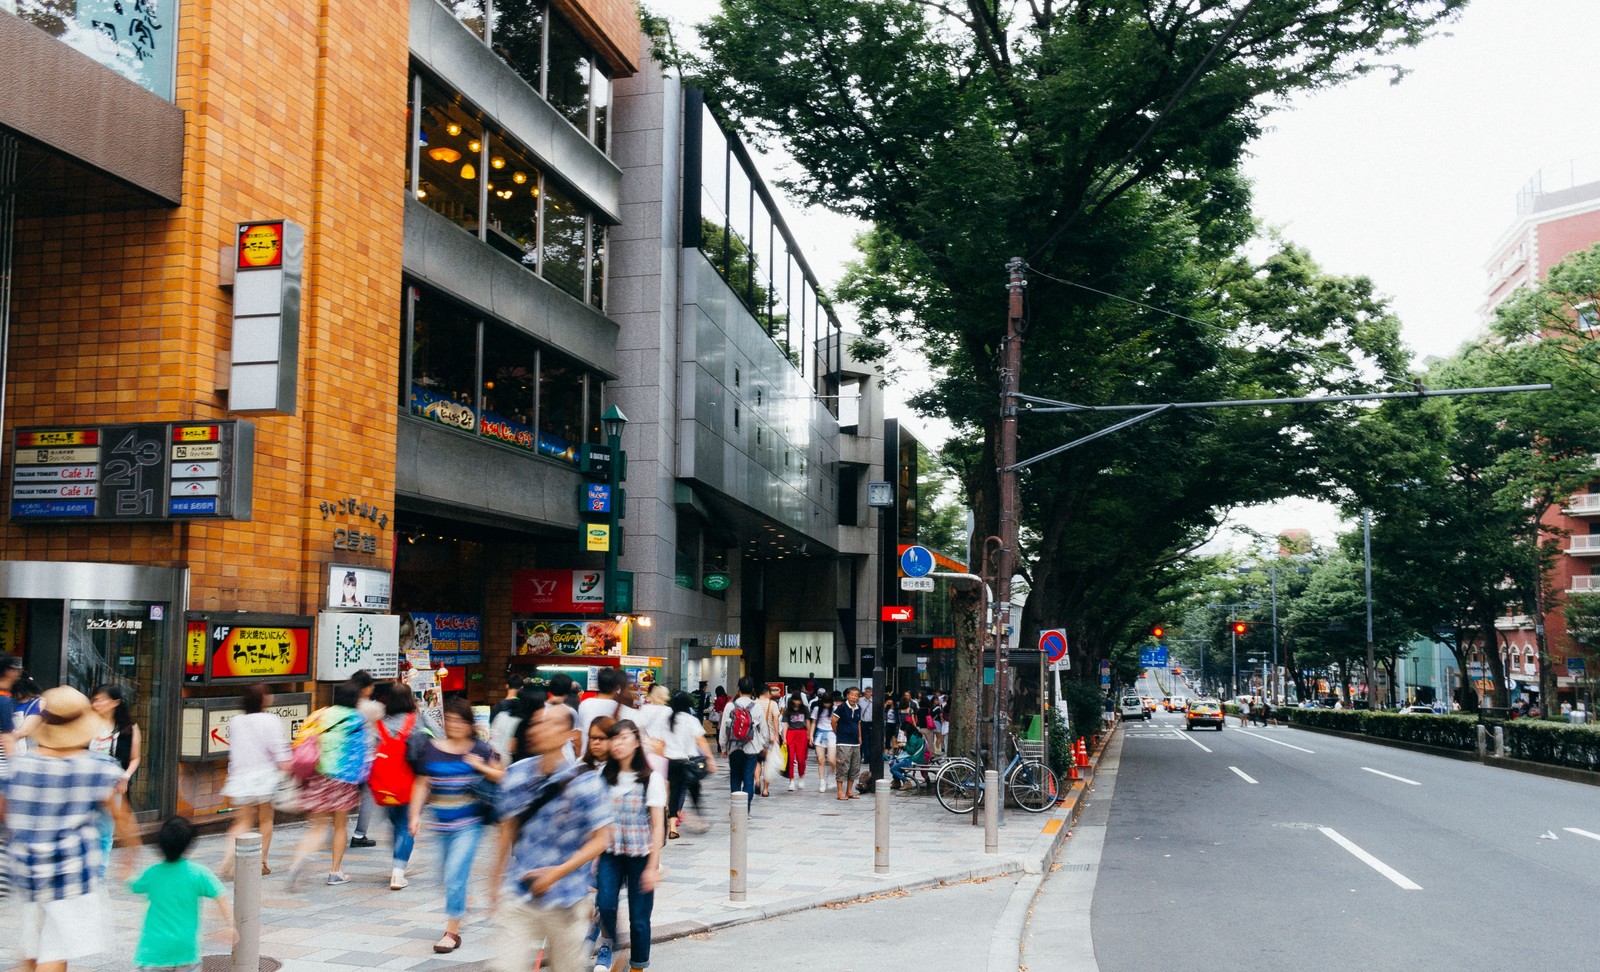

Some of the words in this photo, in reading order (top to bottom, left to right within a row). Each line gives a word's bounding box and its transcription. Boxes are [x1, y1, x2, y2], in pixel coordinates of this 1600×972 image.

[111, 429, 139, 455] 4
[135, 439, 162, 467] 3
[61, 467, 82, 479] Café
[85, 468, 95, 478] Jr.
[103, 459, 132, 485] 2
[60, 484, 81, 496] Café
[84, 486, 95, 496] Jr.
[116, 489, 154, 515] B1
[334, 528, 377, 554] 2号館
[528, 578, 557, 596] Y!
[902, 580, 931, 588] 歩行者優先
[213, 627, 230, 641] 4F
[239, 630, 287, 640] 炭火焼だいにんぐ
[789, 645, 822, 664] MINX
